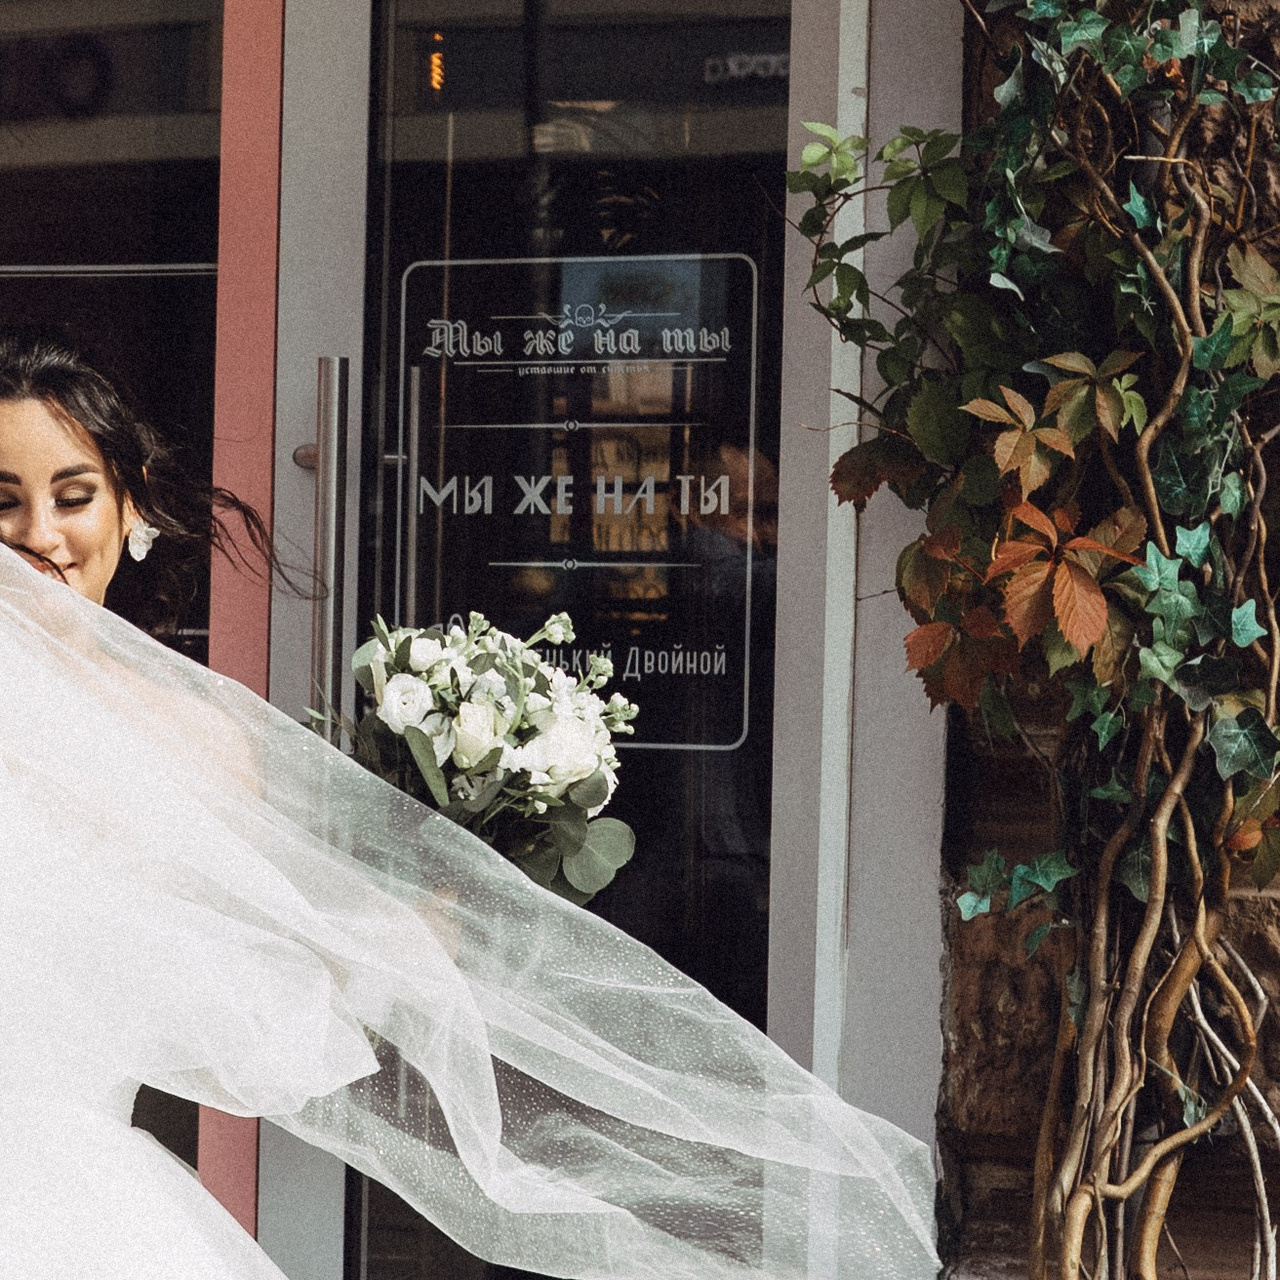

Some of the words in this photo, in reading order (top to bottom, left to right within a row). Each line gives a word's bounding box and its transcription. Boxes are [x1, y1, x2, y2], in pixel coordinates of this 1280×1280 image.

[422, 318, 504, 358] Мы
[522, 328, 575, 356] же
[593, 327, 642, 355] на
[661, 326, 732, 354] ты
[419, 475, 494, 515] МЫ
[512, 474, 575, 515] ЖЕ
[596, 475, 656, 515] НА
[676, 475, 730, 515] ТЫ
